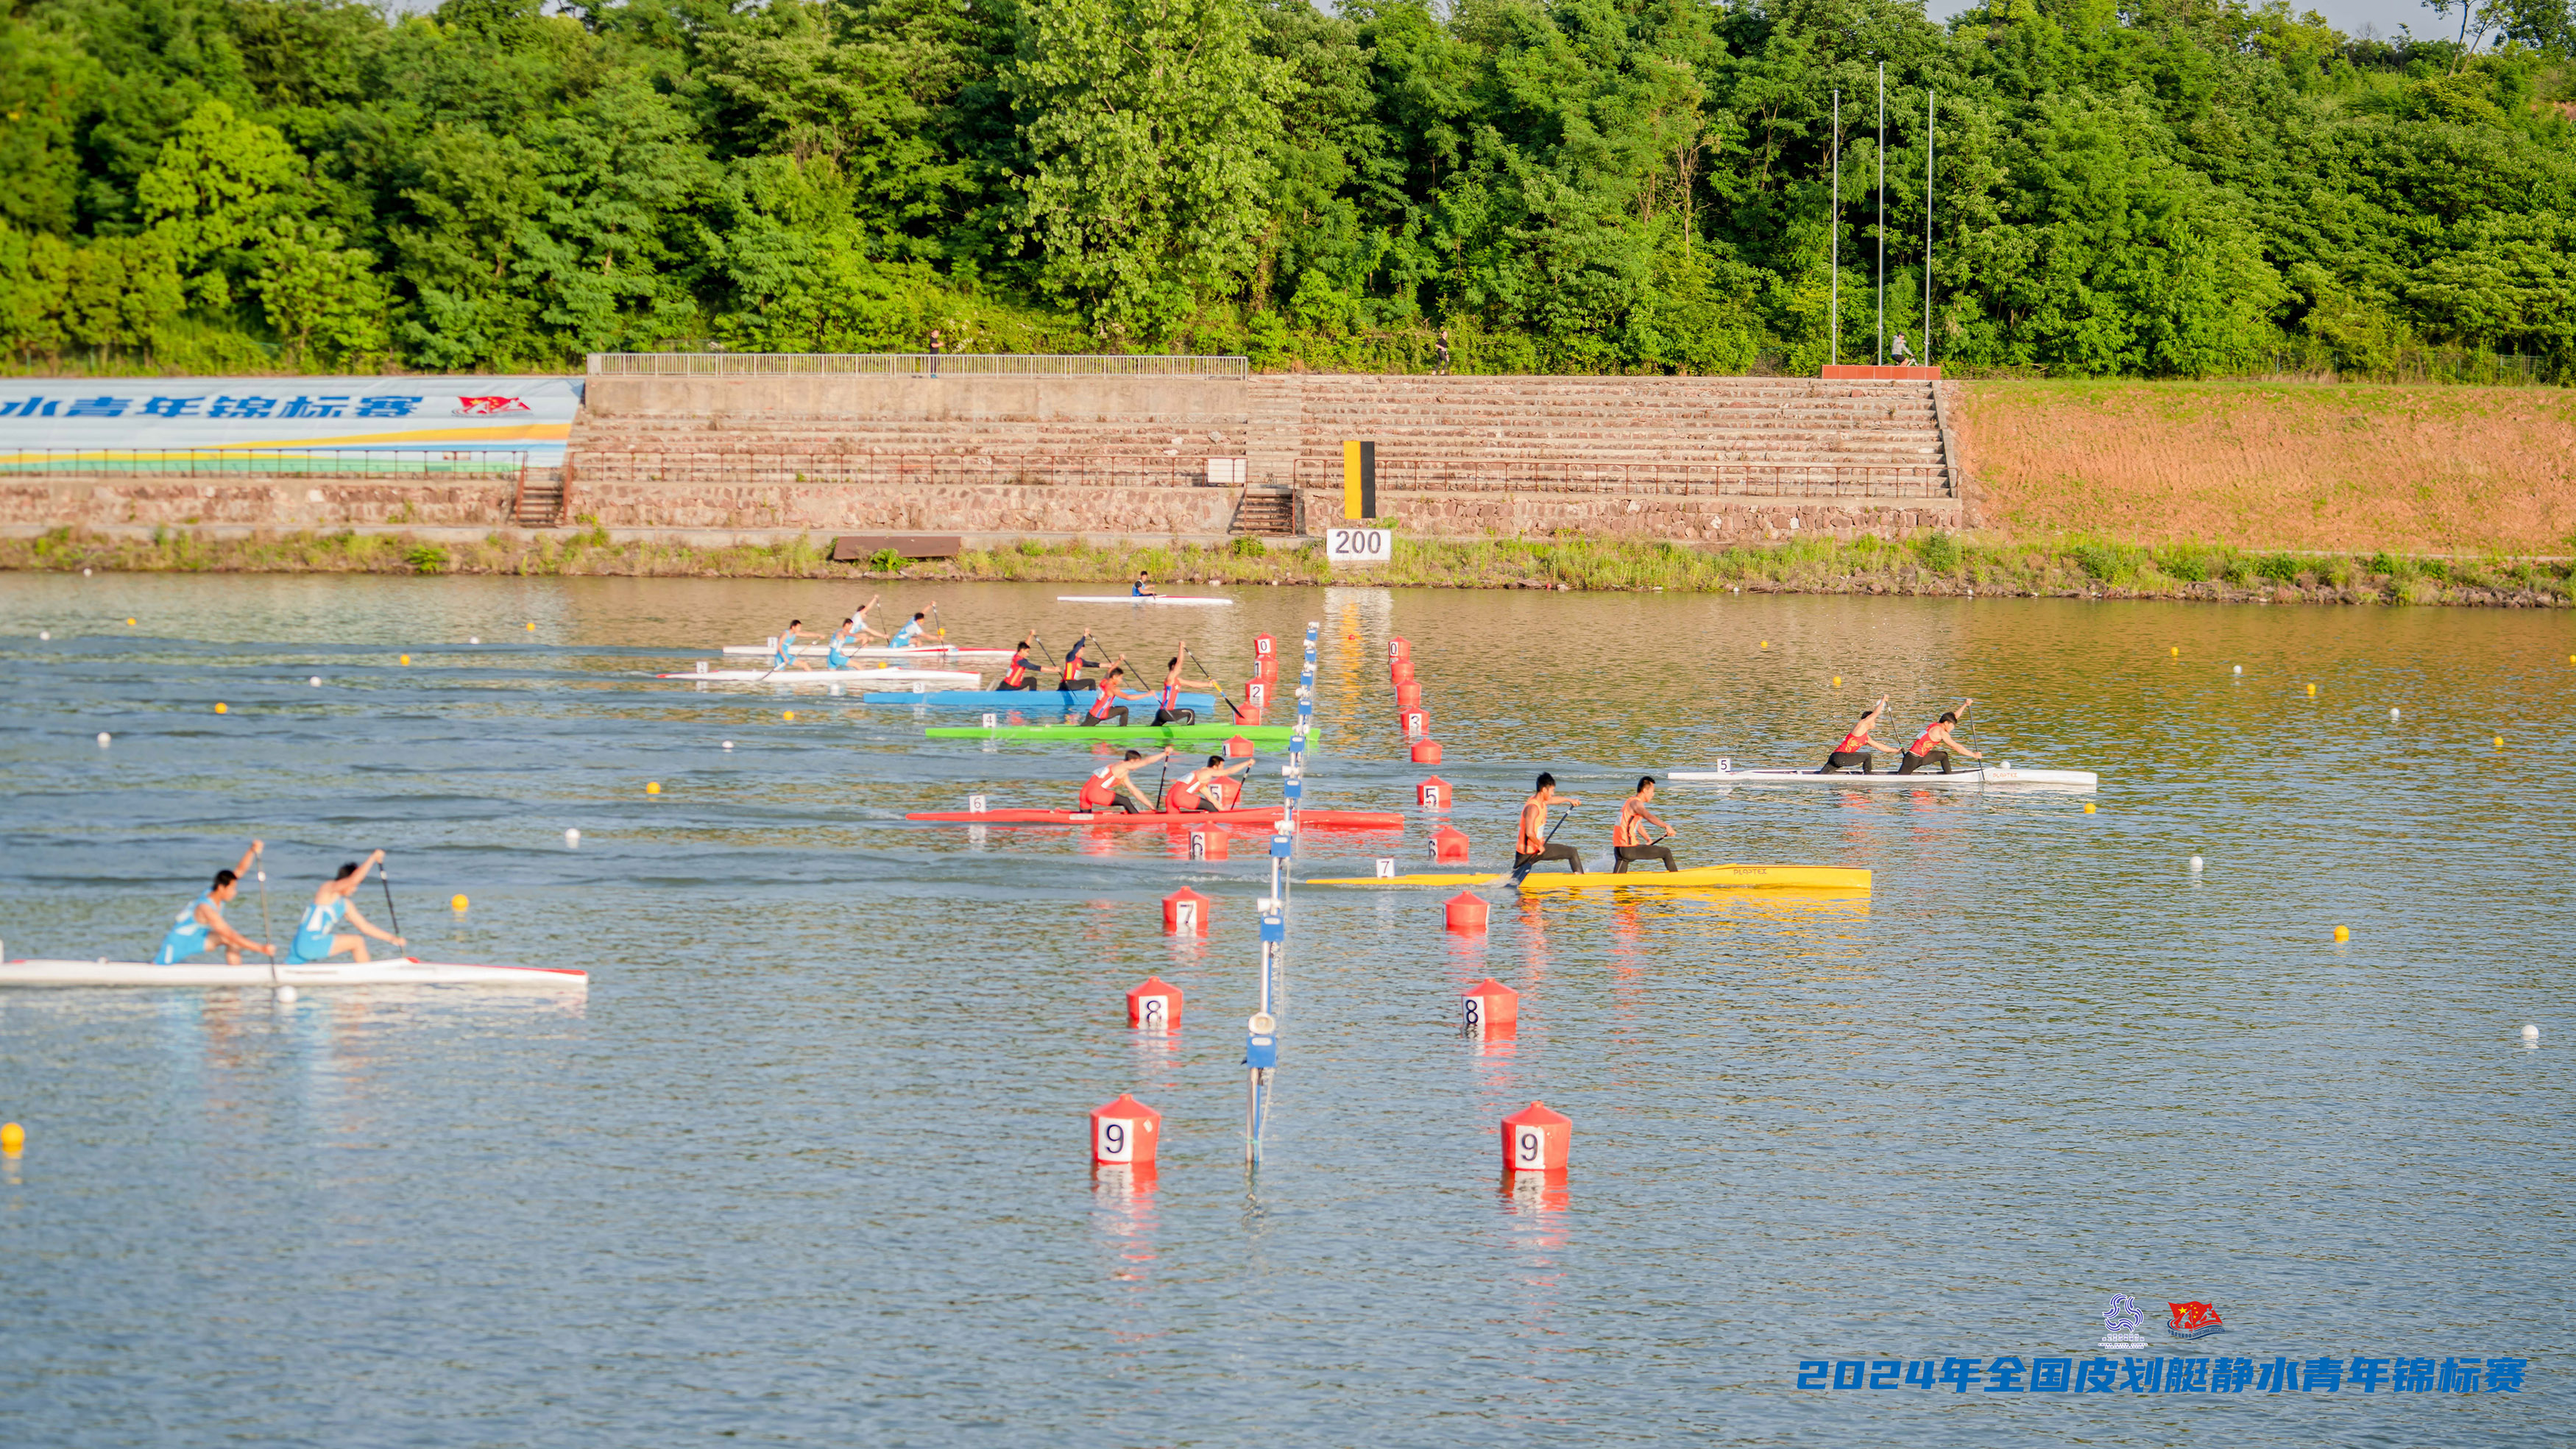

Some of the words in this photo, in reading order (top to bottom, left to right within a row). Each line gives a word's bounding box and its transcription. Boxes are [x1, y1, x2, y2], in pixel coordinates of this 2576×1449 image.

[0, 396, 423, 417] 水青年锦标赛
[1335, 531, 1381, 553] 200
[916, 684, 921, 692] 3
[1253, 686, 1261, 698] 2
[986, 715, 992, 724] 4
[1411, 715, 1420, 730] 3
[1720, 759, 1727, 770] 5
[974, 797, 981, 808] 6
[1425, 788, 1437, 805] 5
[1192, 835, 1203, 856] 6
[1428, 840, 1436, 857] 6
[1381, 860, 1390, 874] 7
[1179, 904, 1193, 924] 7
[1146, 1000, 1161, 1023] 8
[1465, 999, 1478, 1024] 8
[1105, 1124, 1124, 1154] 9
[1521, 1133, 1538, 1161] 9
